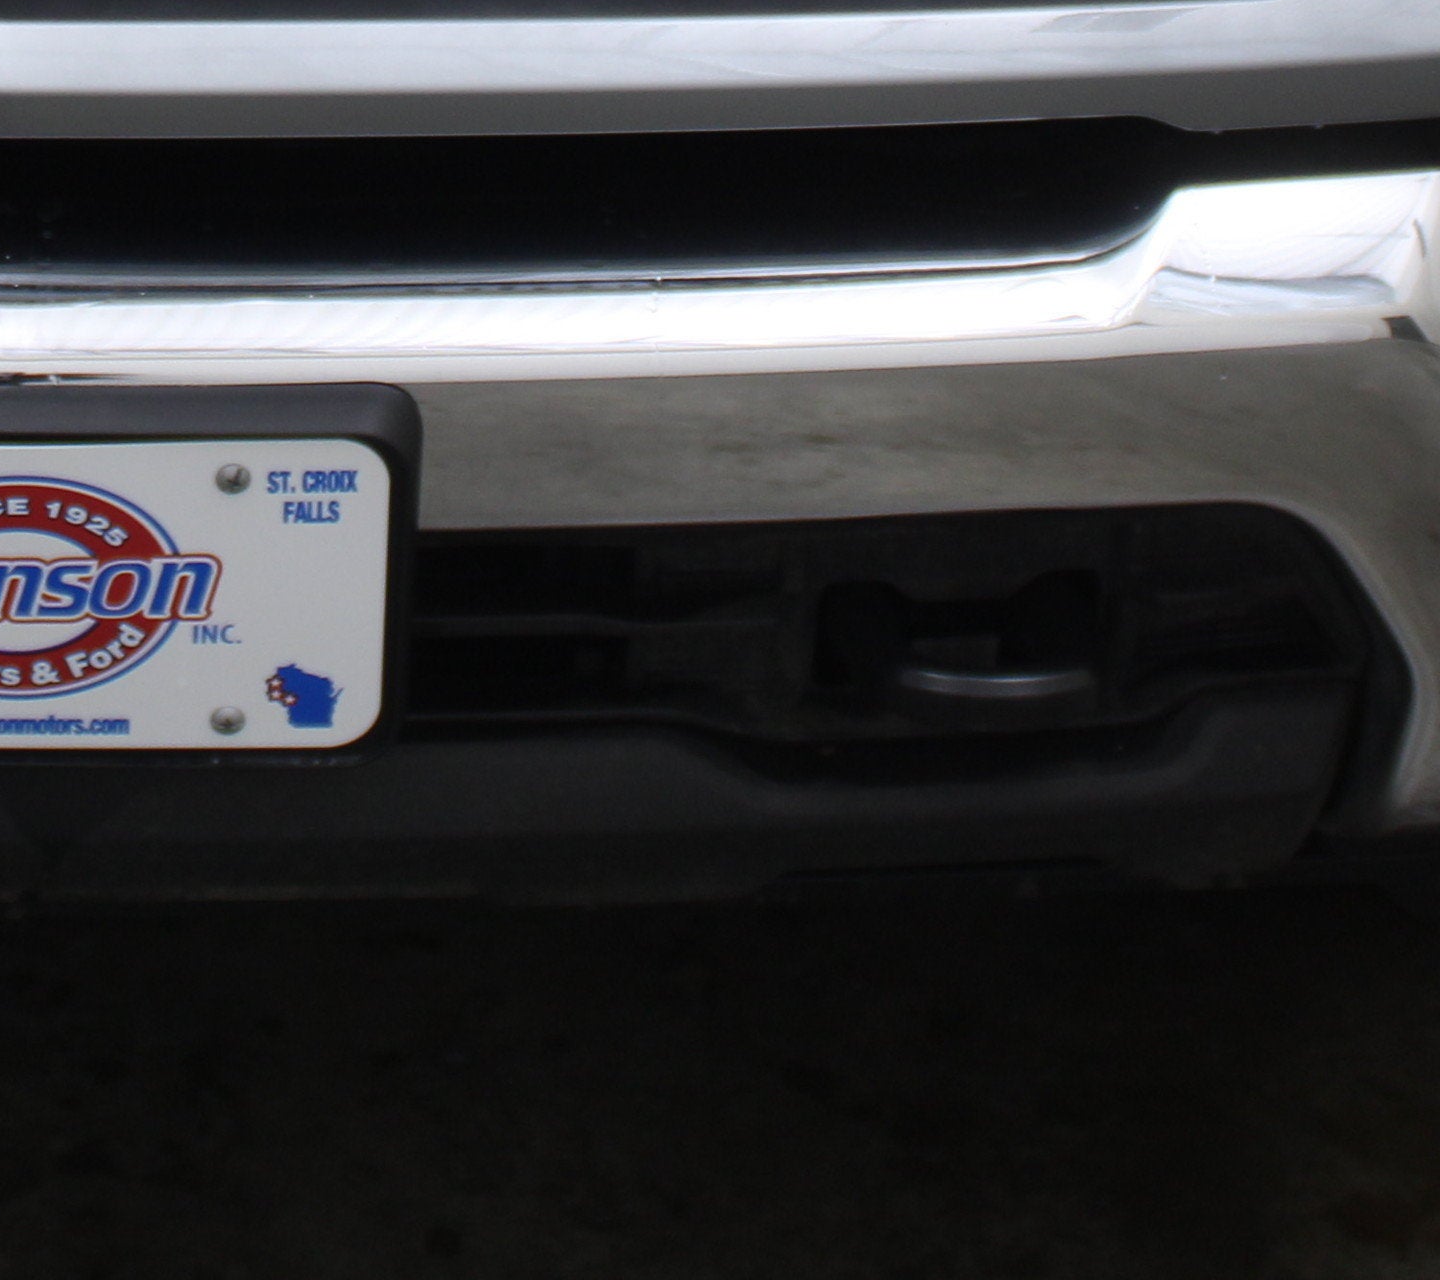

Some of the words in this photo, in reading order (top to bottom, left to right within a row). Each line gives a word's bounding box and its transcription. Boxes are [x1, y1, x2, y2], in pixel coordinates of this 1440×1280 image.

[267, 471, 296, 493] ST.
[302, 470, 358, 493] CROIX
[45, 499, 130, 547] 1925
[283, 501, 340, 524] FALLS
[191, 624, 242, 645] INC.
[30, 659, 61, 686] &
[64, 622, 147, 679] Ford
